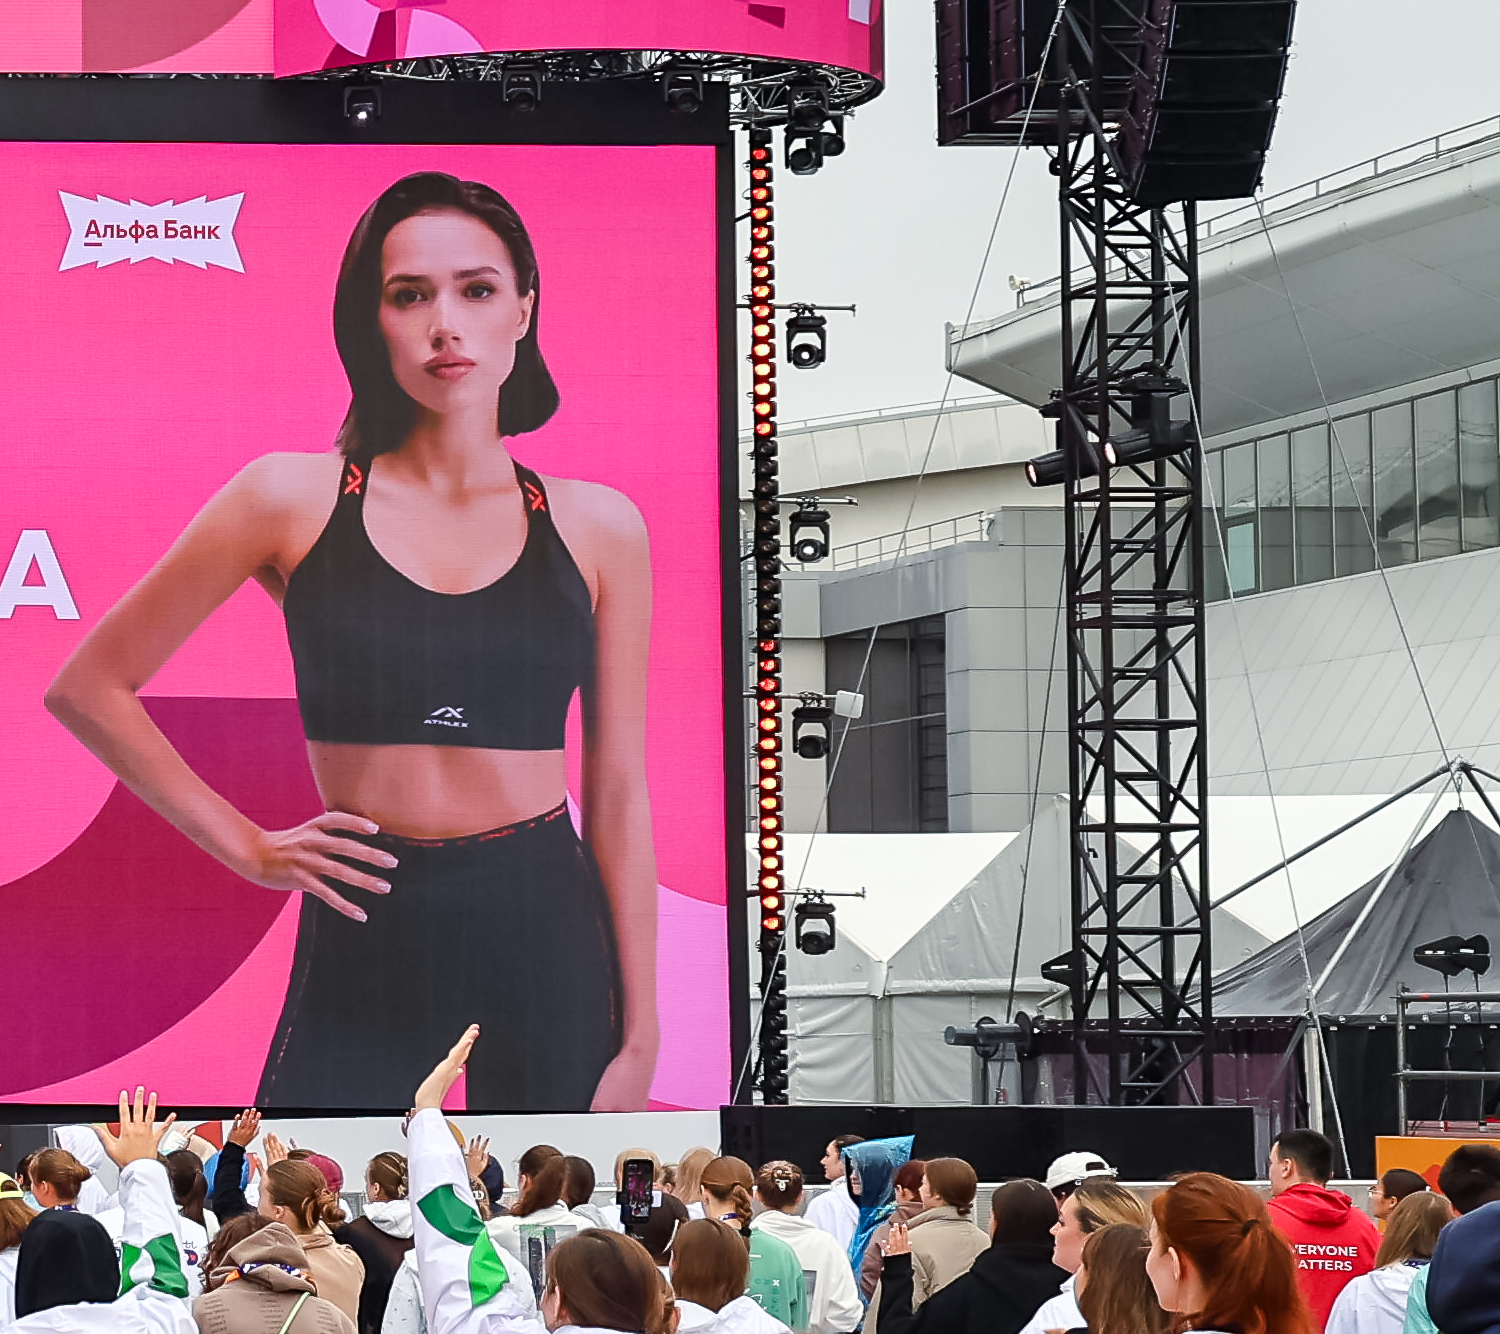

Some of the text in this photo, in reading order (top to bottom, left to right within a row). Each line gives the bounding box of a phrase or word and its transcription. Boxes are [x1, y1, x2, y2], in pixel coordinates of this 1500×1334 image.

[84, 218, 221, 246] Альфа Банк
[1295, 1245, 1358, 1257] ERYONE
[1298, 1259, 1353, 1272] ATTERS
